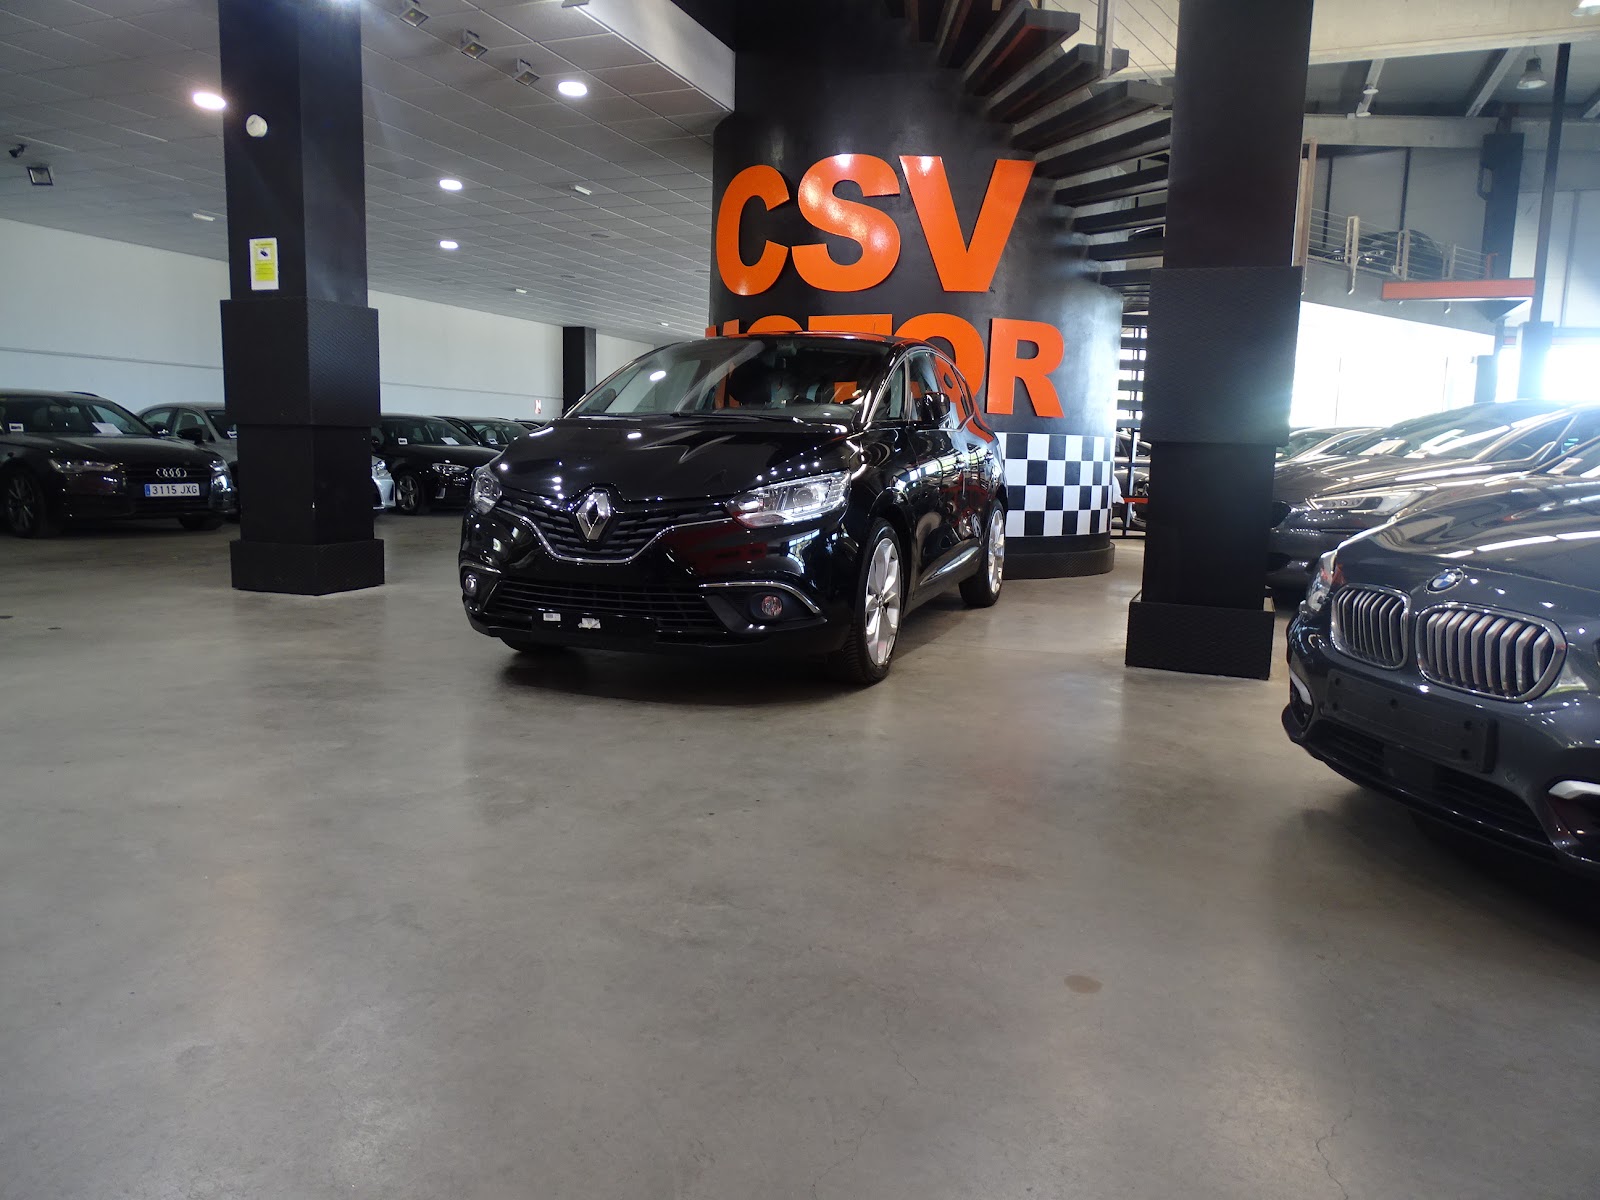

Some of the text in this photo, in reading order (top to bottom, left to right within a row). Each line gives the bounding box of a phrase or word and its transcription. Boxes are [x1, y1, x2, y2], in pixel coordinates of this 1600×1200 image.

[716, 153, 1036, 296] CSV
[152, 484, 198, 495] 3115 JXG
